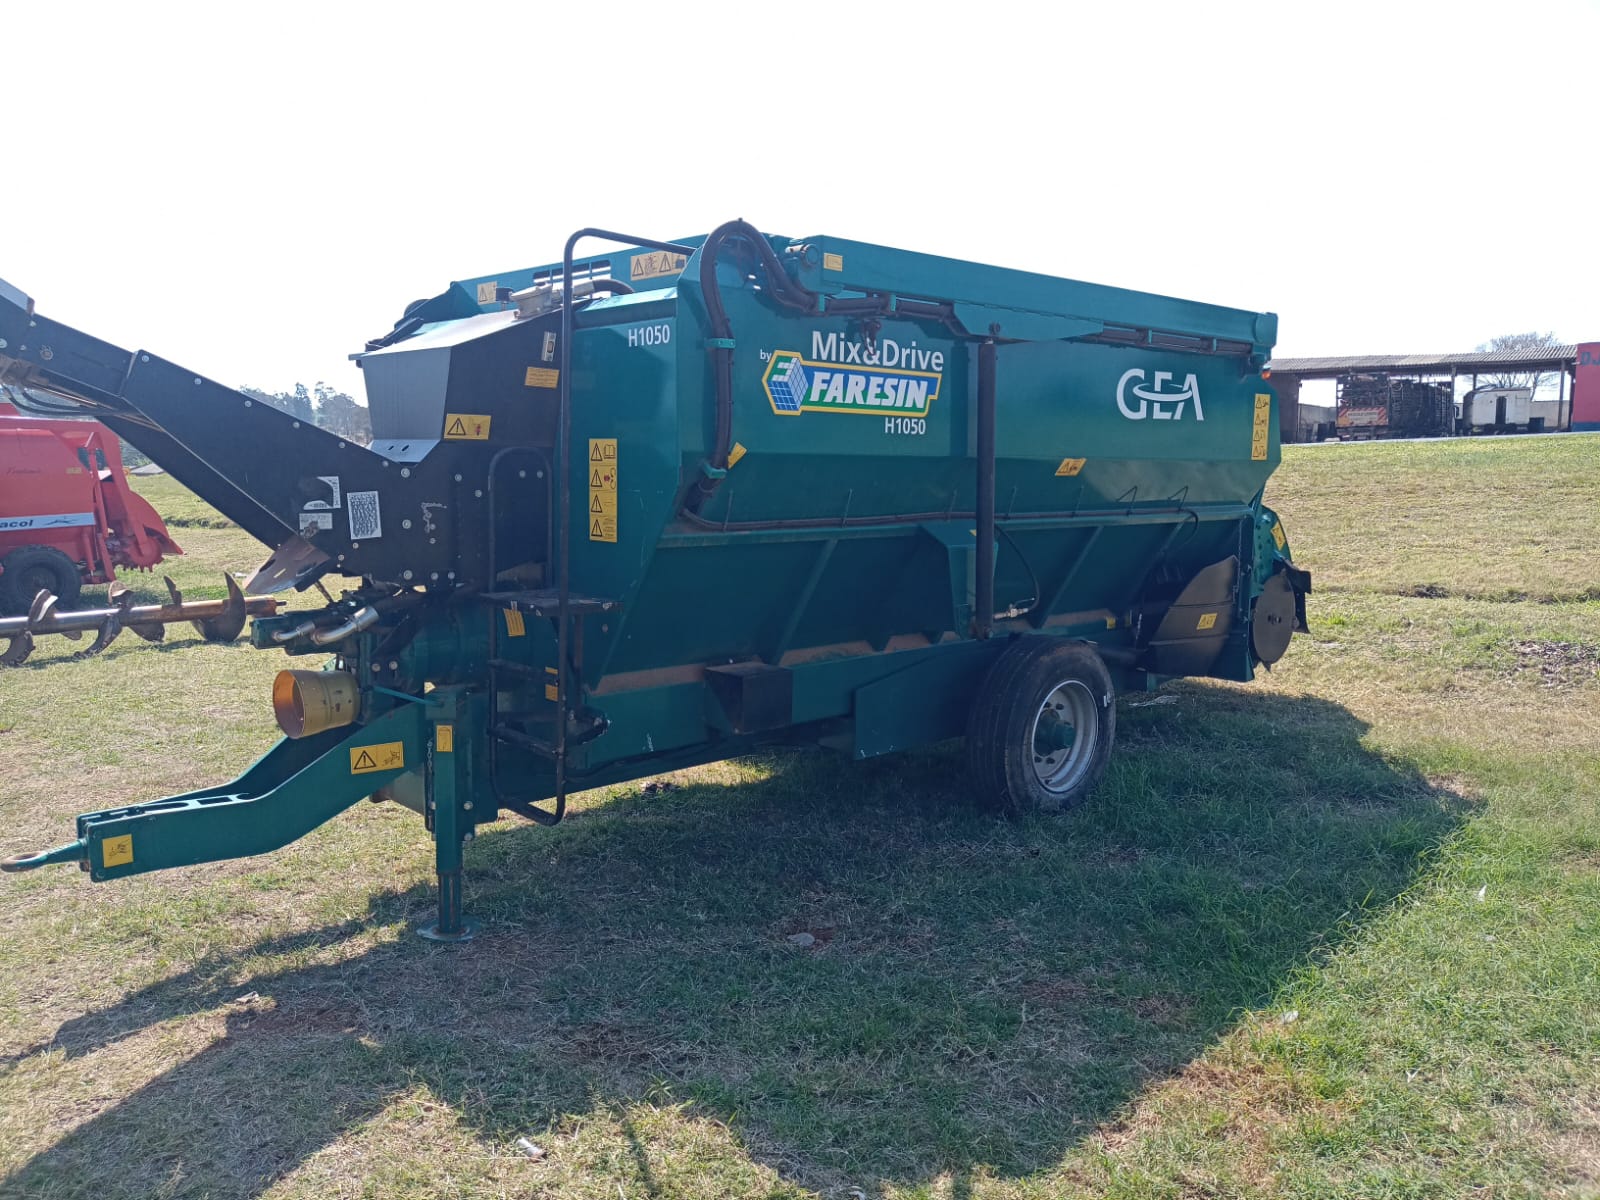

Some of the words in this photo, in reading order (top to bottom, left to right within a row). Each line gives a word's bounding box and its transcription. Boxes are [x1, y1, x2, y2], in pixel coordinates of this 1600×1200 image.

[628, 324, 670, 347] H1050
[759, 348, 772, 363] by
[811, 330, 944, 372] Mix&Drive
[809, 371, 928, 409] FARESIN
[1116, 368, 1204, 421] GEA
[884, 417, 926, 435] H1050
